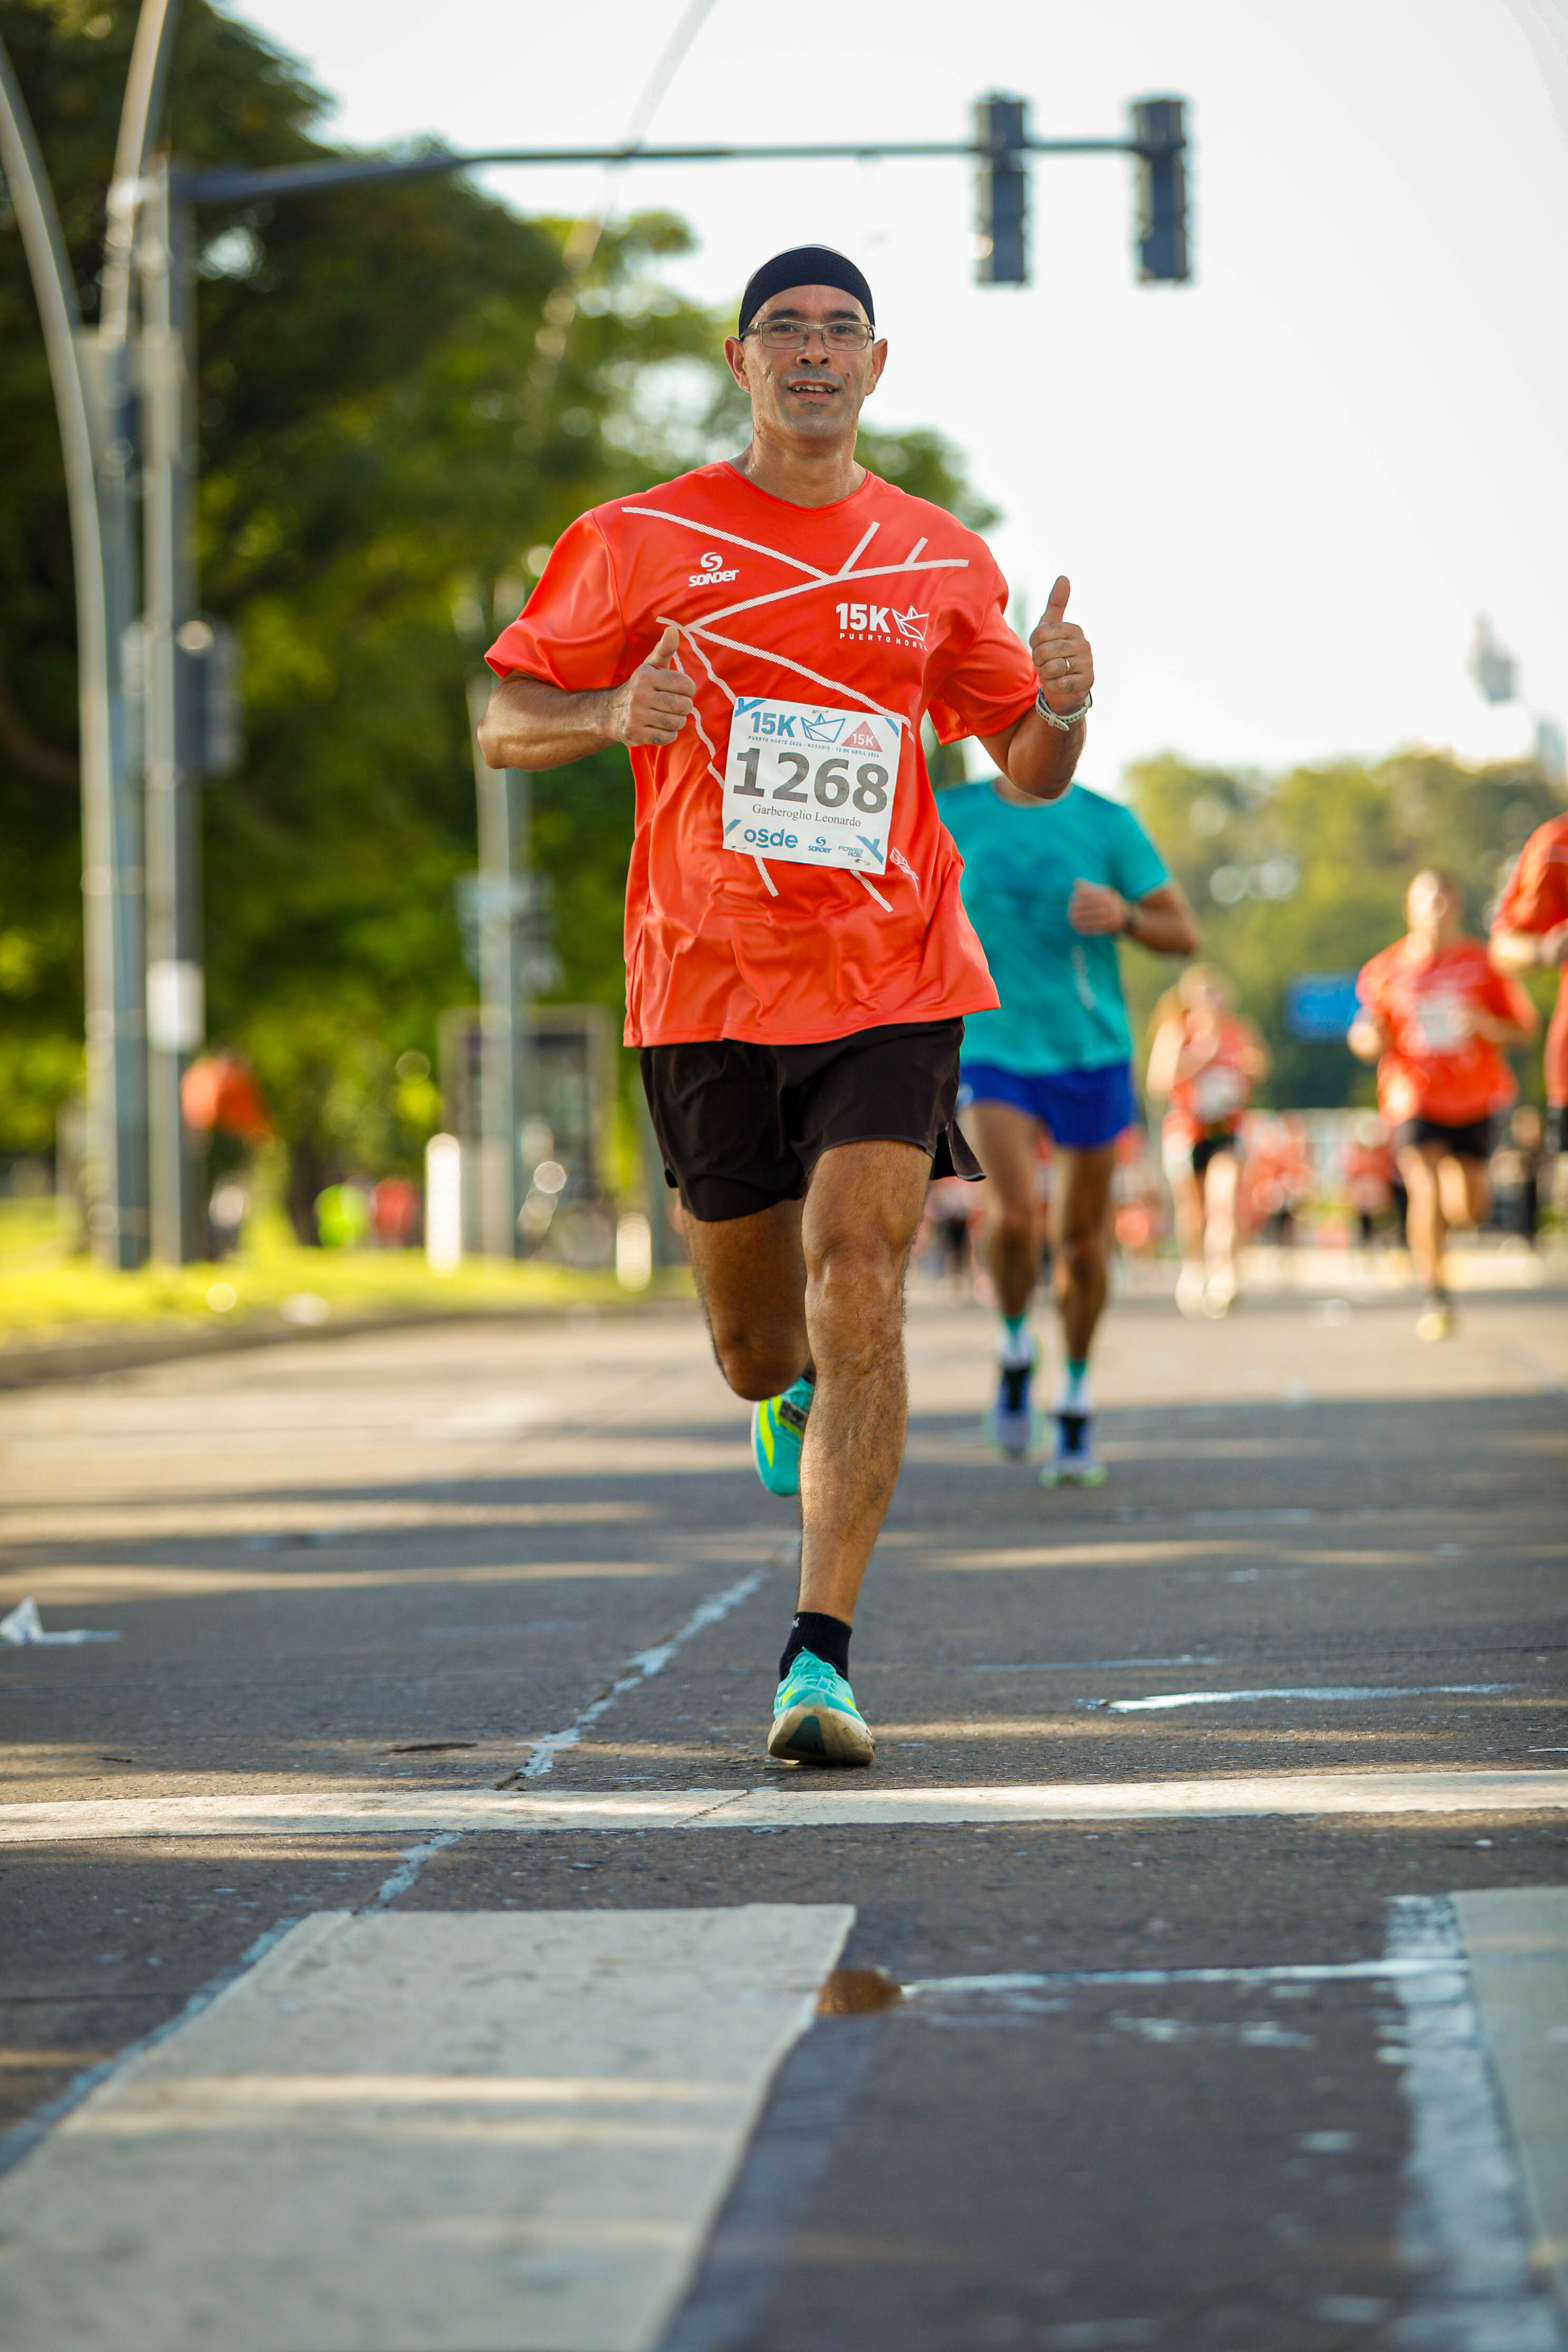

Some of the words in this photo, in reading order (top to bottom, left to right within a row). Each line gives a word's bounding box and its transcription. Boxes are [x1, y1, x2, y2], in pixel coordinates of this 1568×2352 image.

[836, 602, 891, 633] 15K
[839, 633, 890, 643] PUERTO
[751, 711, 797, 737] 15K
[852, 733, 874, 747] 15K
[733, 747, 889, 814] 1268
[752, 804, 812, 820] Garberoglio
[815, 812, 861, 827] Leonardo
[743, 828, 798, 848] osde
